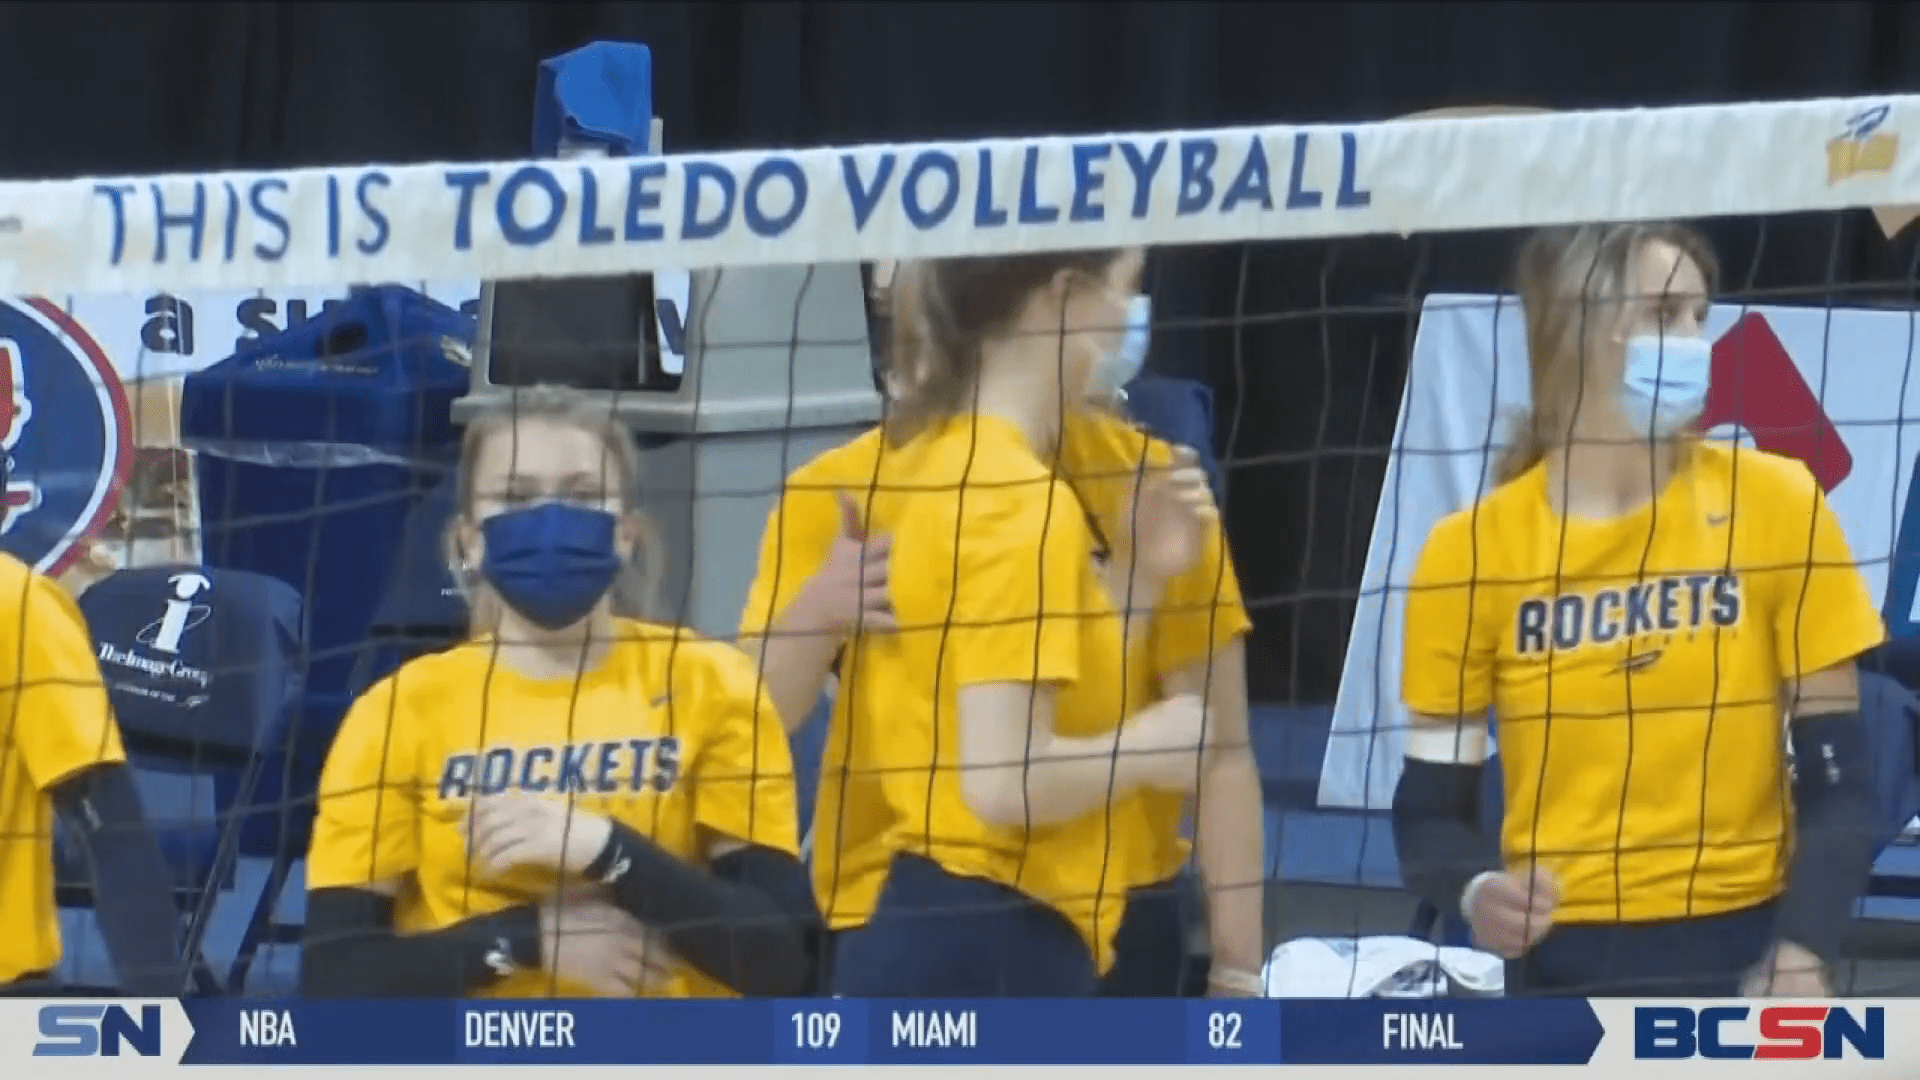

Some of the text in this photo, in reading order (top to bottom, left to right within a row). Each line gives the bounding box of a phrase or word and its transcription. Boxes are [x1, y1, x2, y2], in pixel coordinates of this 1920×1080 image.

[93, 132, 1371, 266] THIS IS TOLEDO VOLLEYBALL
[1516, 574, 1740, 654] ROCKETS
[438, 736, 680, 800] ROCKETS
